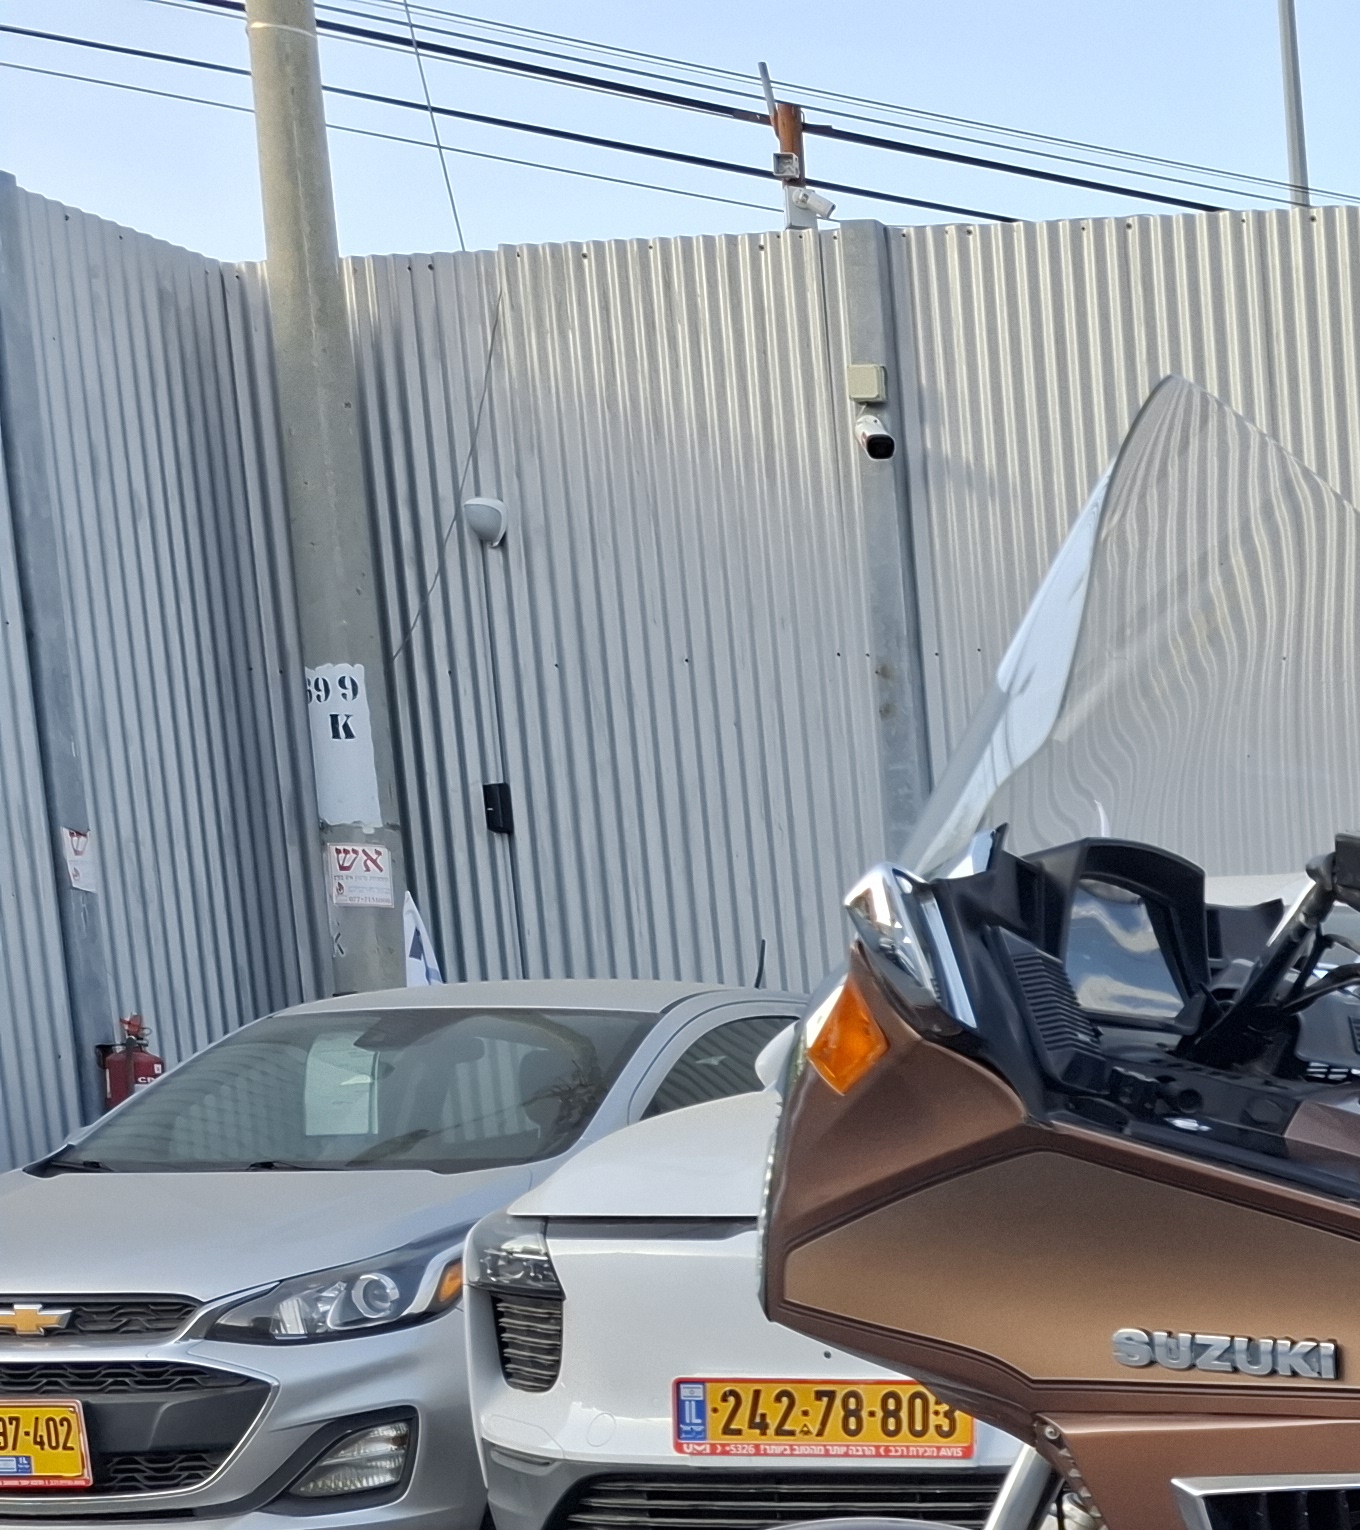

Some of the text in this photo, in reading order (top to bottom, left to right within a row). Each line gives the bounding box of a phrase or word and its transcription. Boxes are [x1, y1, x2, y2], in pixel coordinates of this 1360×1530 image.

[329, 713, 356, 740] K
[335, 847, 383, 872] אש
[1112, 1327, 1338, 1379] SUZUKI
[684, 1400, 702, 1424] IL
